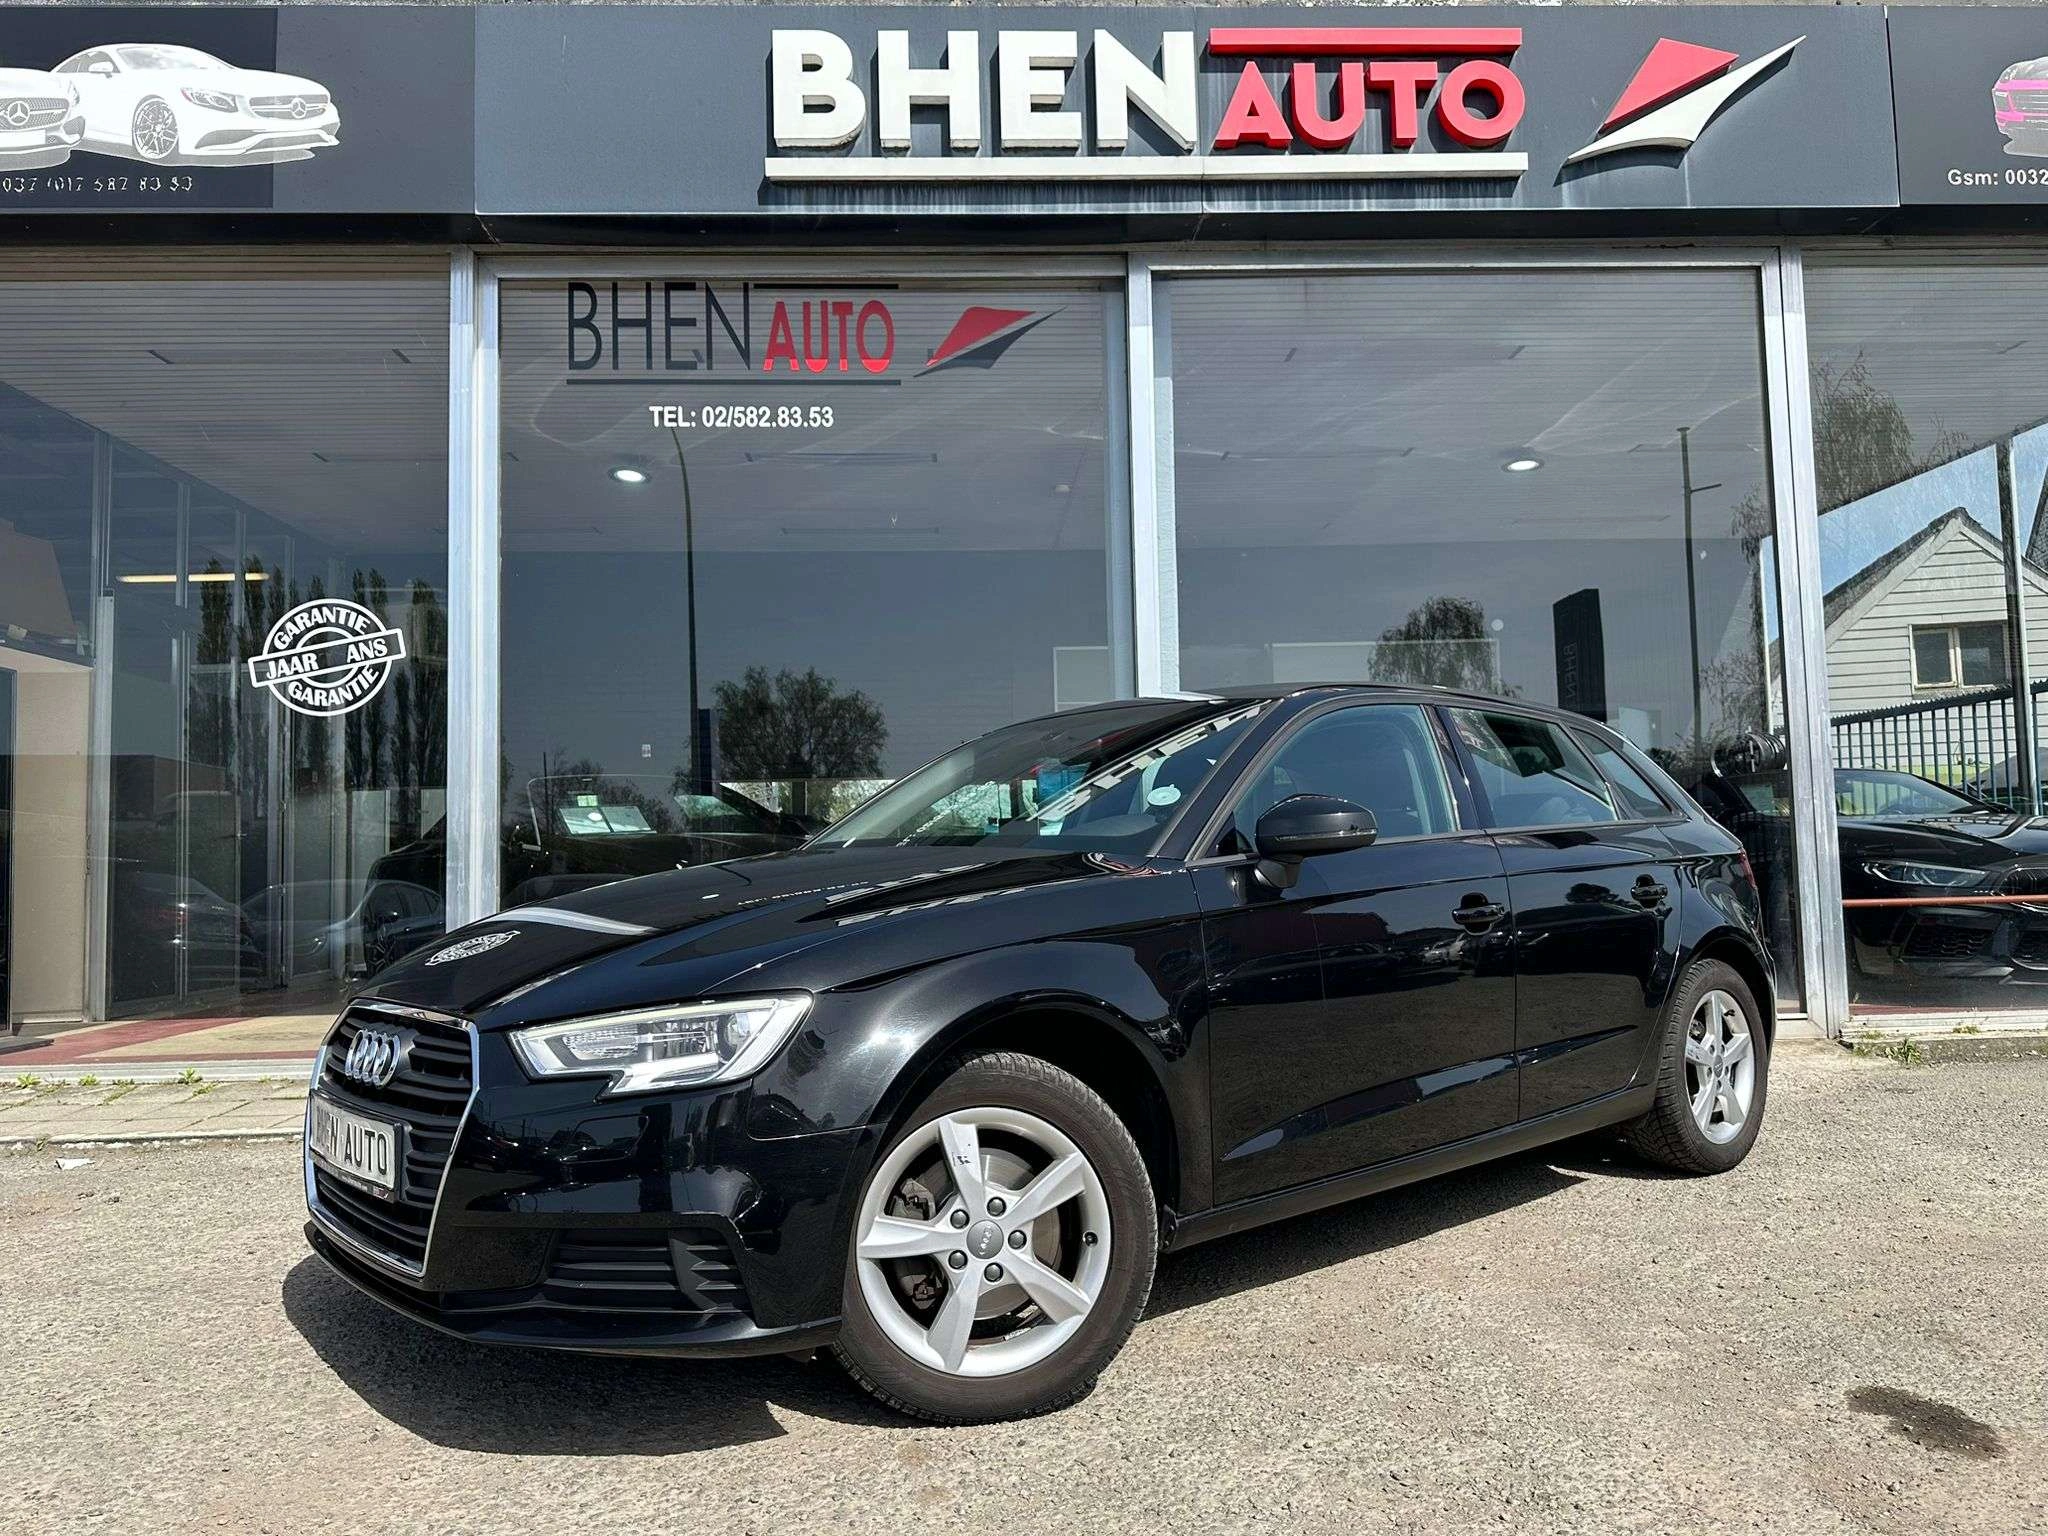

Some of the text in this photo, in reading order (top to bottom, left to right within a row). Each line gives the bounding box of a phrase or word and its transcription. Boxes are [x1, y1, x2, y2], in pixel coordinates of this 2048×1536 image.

[771, 29, 1526, 149] BHEN AUTO
[1947, 169, 1999, 186] Gsm:
[568, 281, 896, 374] BHEN AUTO
[649, 405, 834, 428] TEL: 02/582.83.53
[273, 606, 371, 650] GARANTIE
[266, 638, 388, 680] JAAR ANS
[287, 665, 380, 707] GARANTIE
[344, 1121, 388, 1176] AUTO
